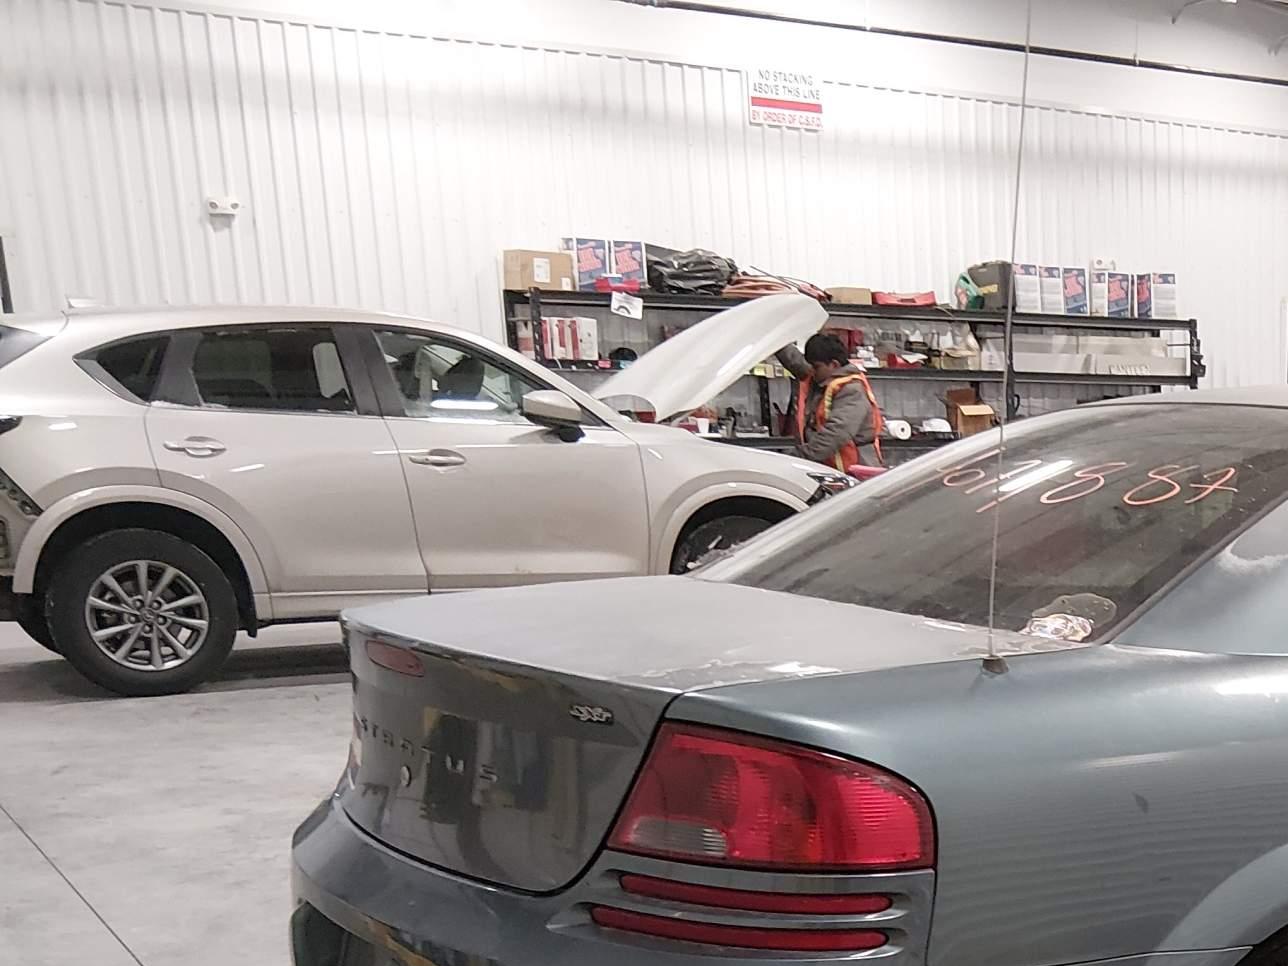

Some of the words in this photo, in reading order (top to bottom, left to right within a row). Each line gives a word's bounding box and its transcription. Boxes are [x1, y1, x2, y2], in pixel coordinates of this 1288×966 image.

[758, 69, 770, 81] NO
[773, 70, 814, 87] STACKING
[753, 83, 780, 96] ABOVE
[783, 86, 801, 98] THIS
[803, 89, 820, 101] LINE
[763, 111, 787, 124] ORDER
[788, 114, 797, 125] OF
[361, 716, 499, 783] STRATUS
